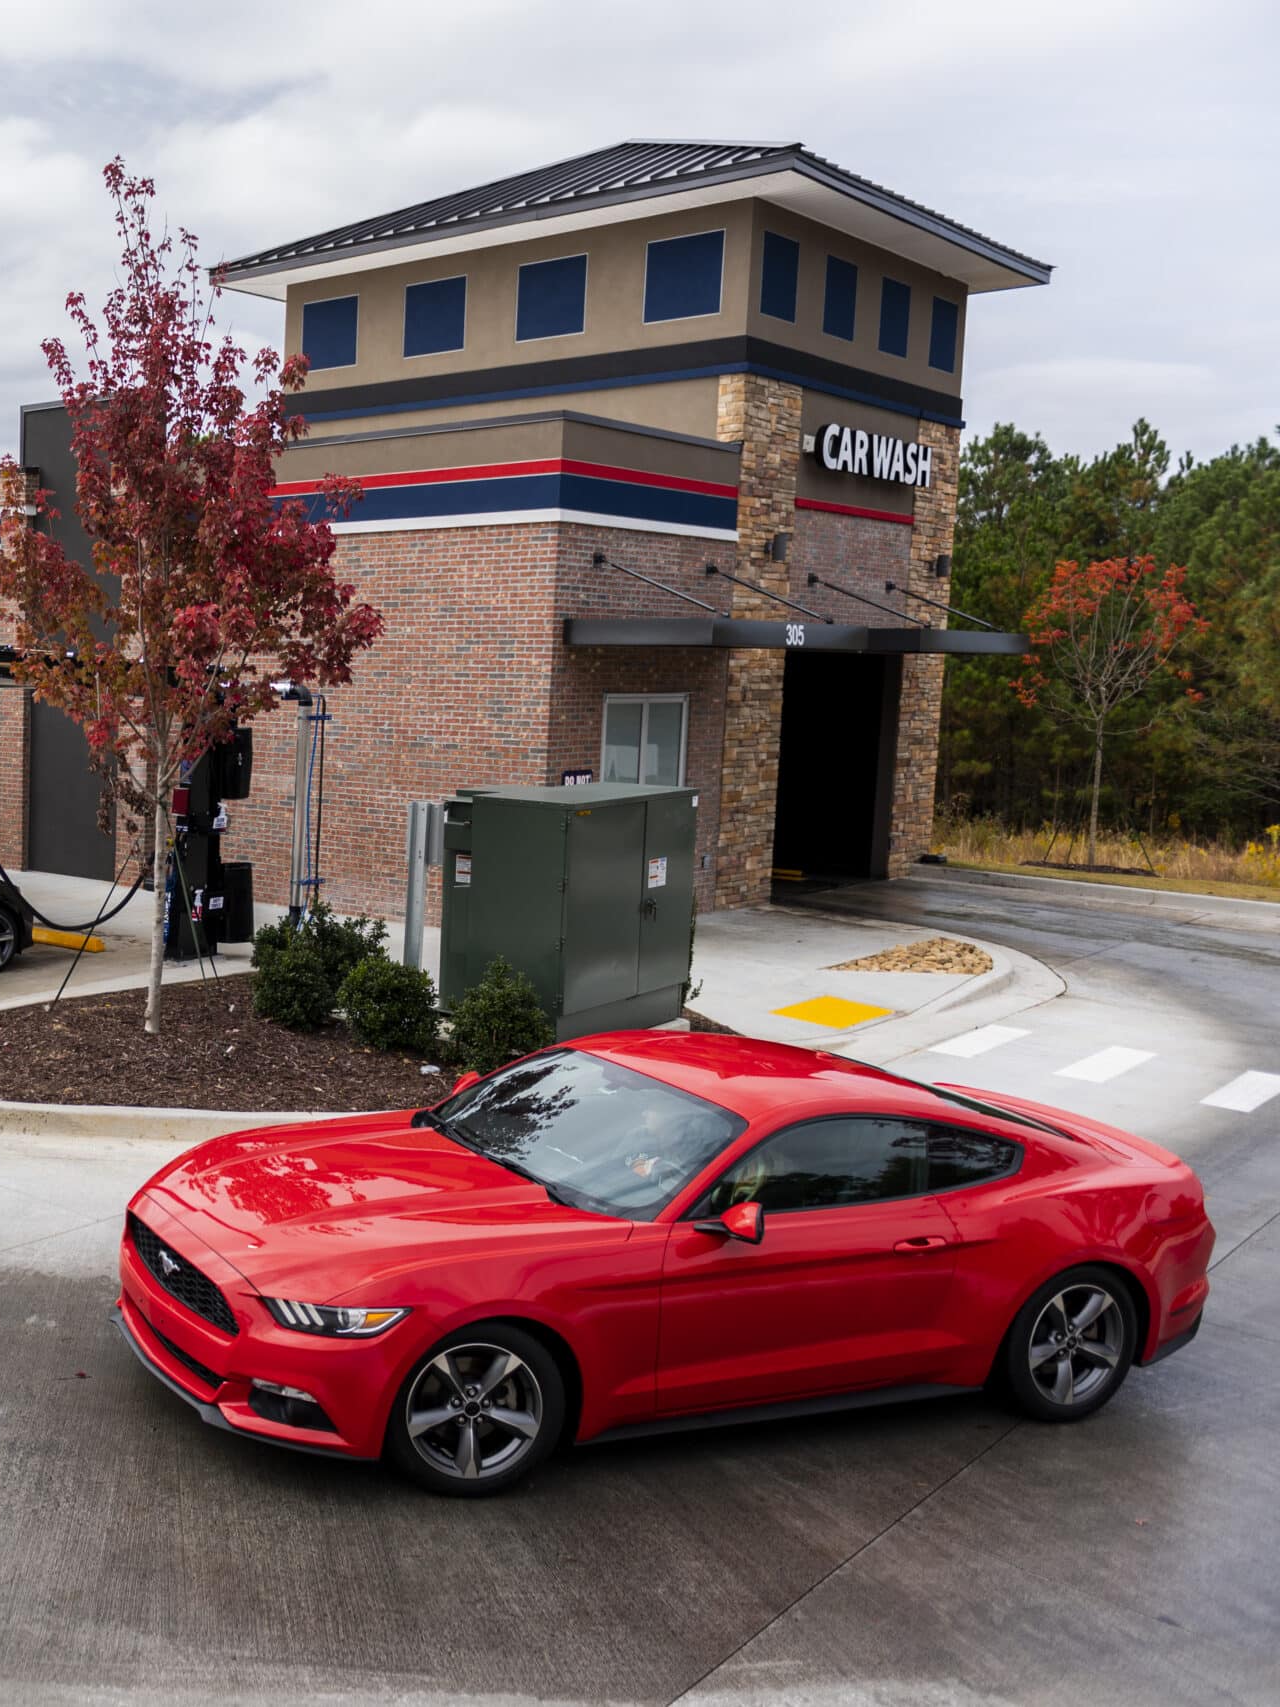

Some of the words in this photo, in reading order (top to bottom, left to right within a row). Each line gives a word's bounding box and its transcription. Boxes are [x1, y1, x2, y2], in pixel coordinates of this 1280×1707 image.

[823, 423, 869, 476] CAR
[873, 434, 932, 488] WASH
[786, 623, 805, 646] 305
[565, 775, 575, 785] DO
[576, 774, 591, 784] NOT
